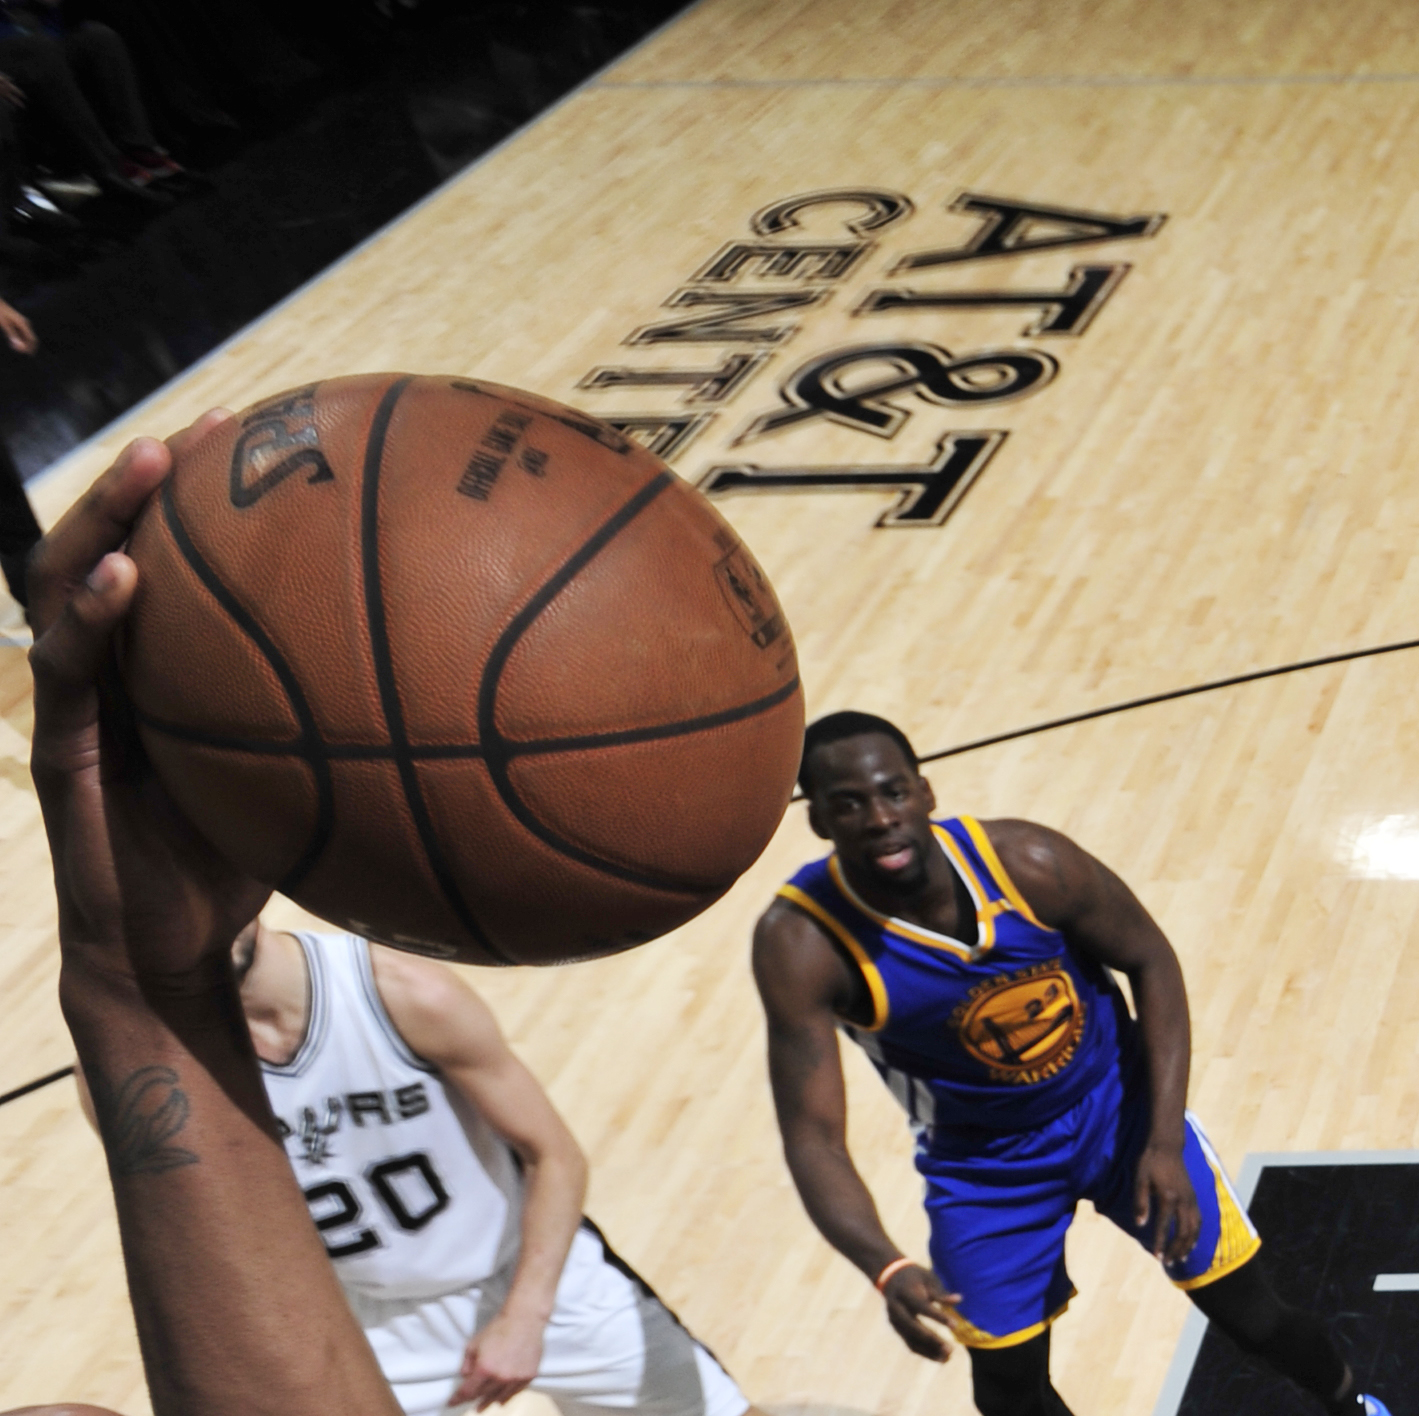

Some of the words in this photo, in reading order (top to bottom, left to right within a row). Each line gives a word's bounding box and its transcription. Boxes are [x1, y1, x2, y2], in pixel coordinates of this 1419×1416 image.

[574, 187, 915, 461] CENTE
[697, 192, 1169, 528] AT&T
[276, 1082, 431, 1152] URS
[303, 1151, 451, 1260] 20
